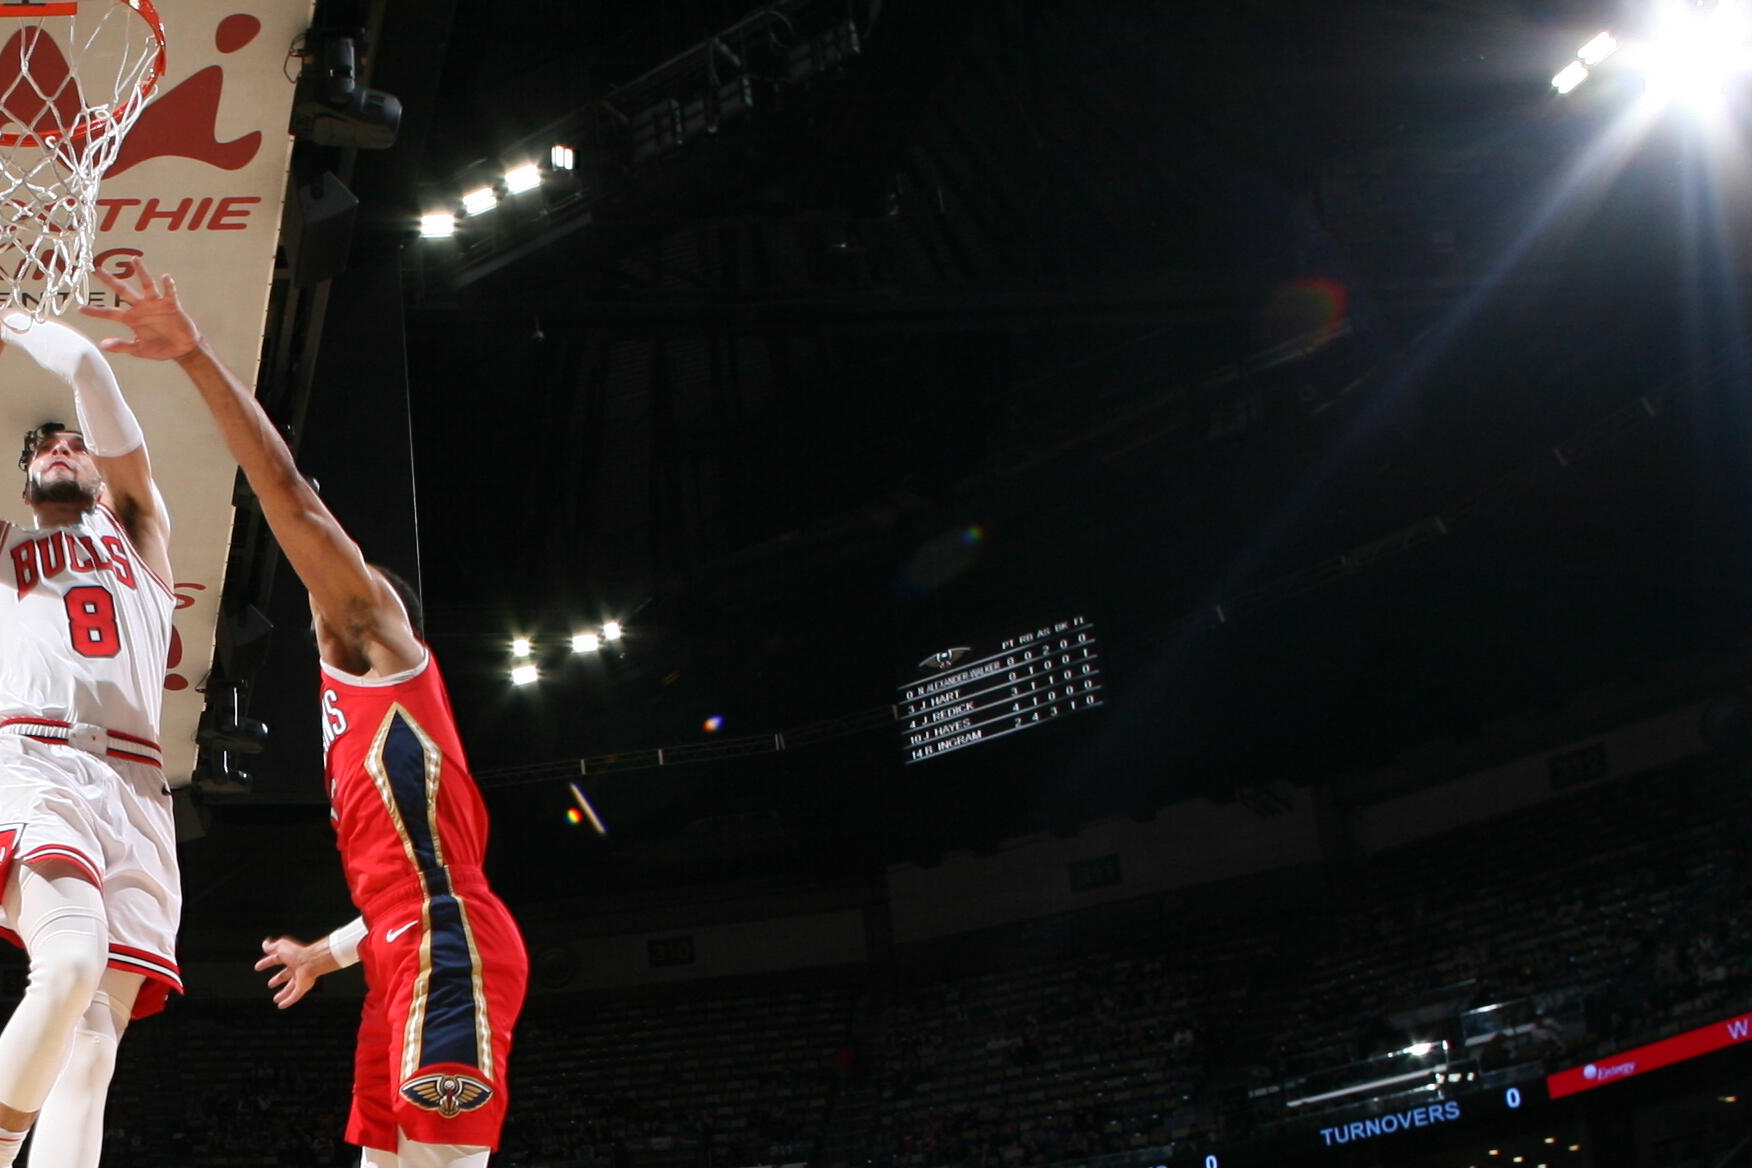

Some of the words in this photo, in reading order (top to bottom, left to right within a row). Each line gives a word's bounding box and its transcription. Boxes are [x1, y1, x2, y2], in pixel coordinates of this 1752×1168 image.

[10, 530, 136, 600] BULLS
[63, 585, 121, 658] 8
[930, 689, 960, 706] HART
[932, 701, 974, 722] REDICK
[934, 718, 971, 736] HAYES
[937, 730, 982, 751] INGRAM
[1320, 1101, 1461, 1146] TURNOVERS
[1506, 1087, 1521, 1109] 0
